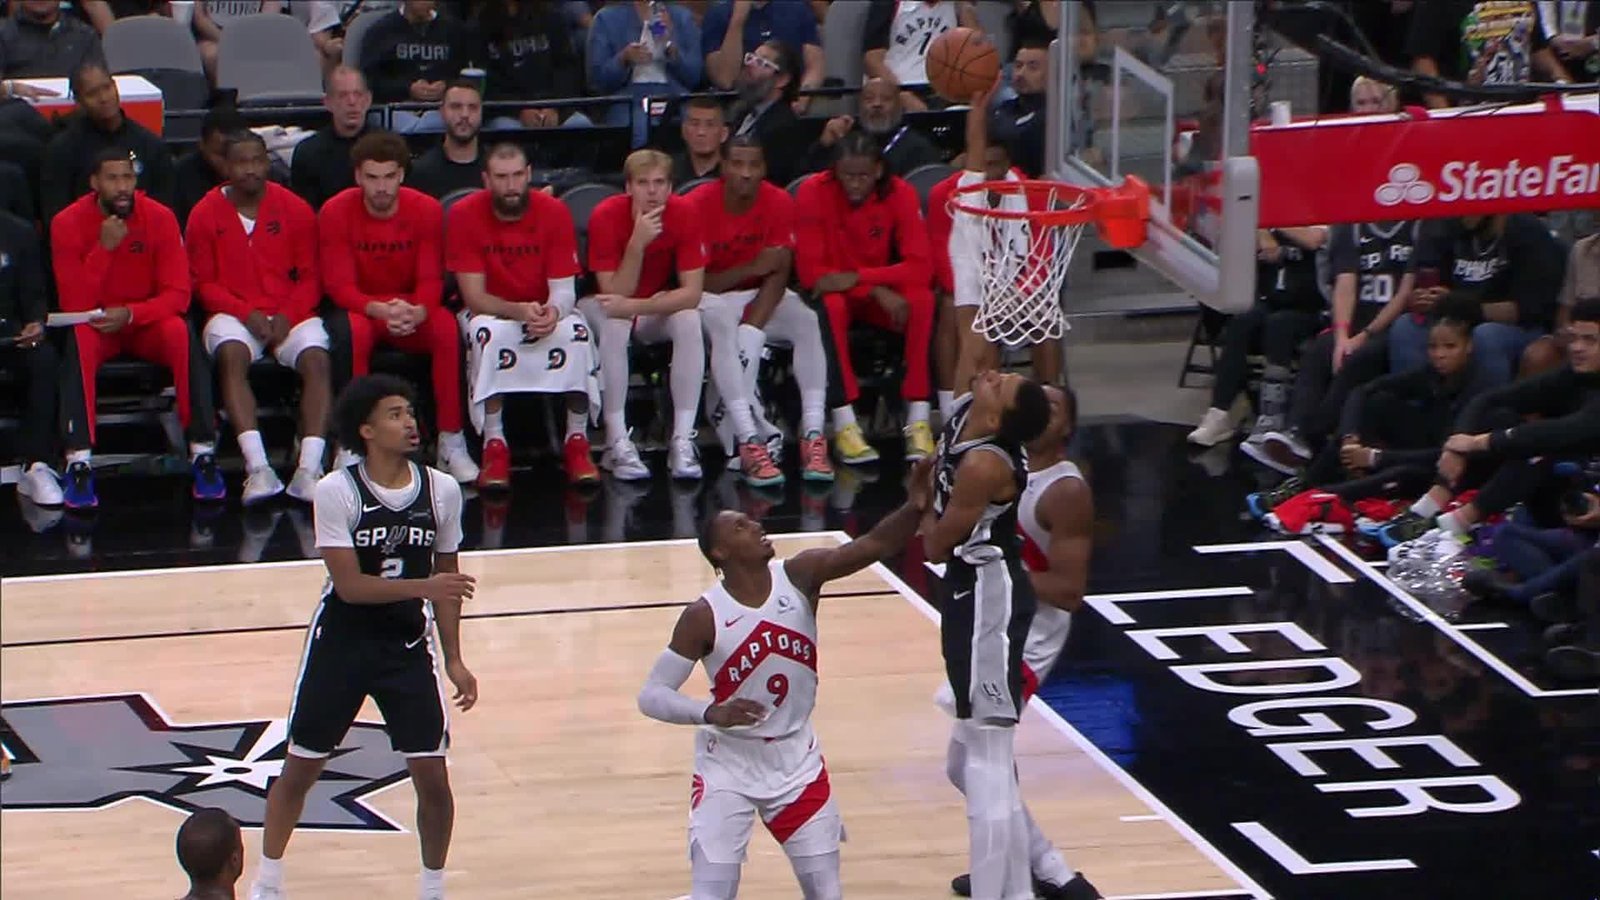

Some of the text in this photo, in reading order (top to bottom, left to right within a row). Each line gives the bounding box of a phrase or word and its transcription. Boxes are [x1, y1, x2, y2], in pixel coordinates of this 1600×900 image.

[1360, 273, 1394, 303] 20
[728, 631, 811, 683] RAPTORS
[766, 673, 790, 708] 9
[1083, 586, 1522, 818] LEDGER
